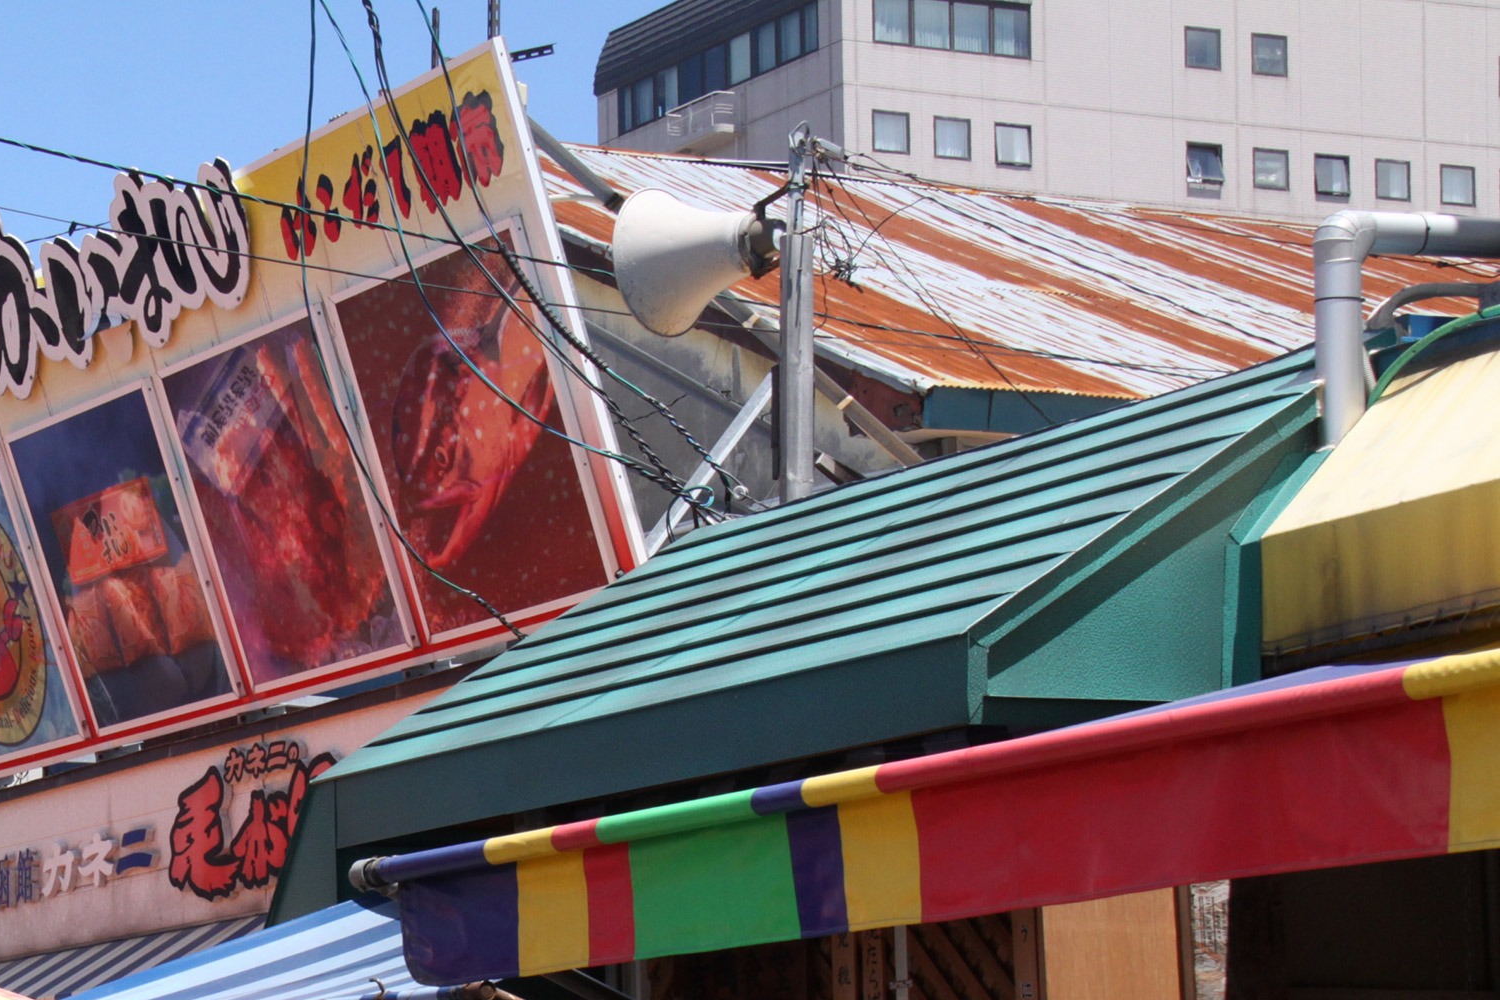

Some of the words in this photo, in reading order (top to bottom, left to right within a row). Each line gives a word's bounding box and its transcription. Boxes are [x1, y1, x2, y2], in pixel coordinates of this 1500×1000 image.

[280, 89, 504, 260] はこだて朝市
[224, 741, 300, 783] カネニの
